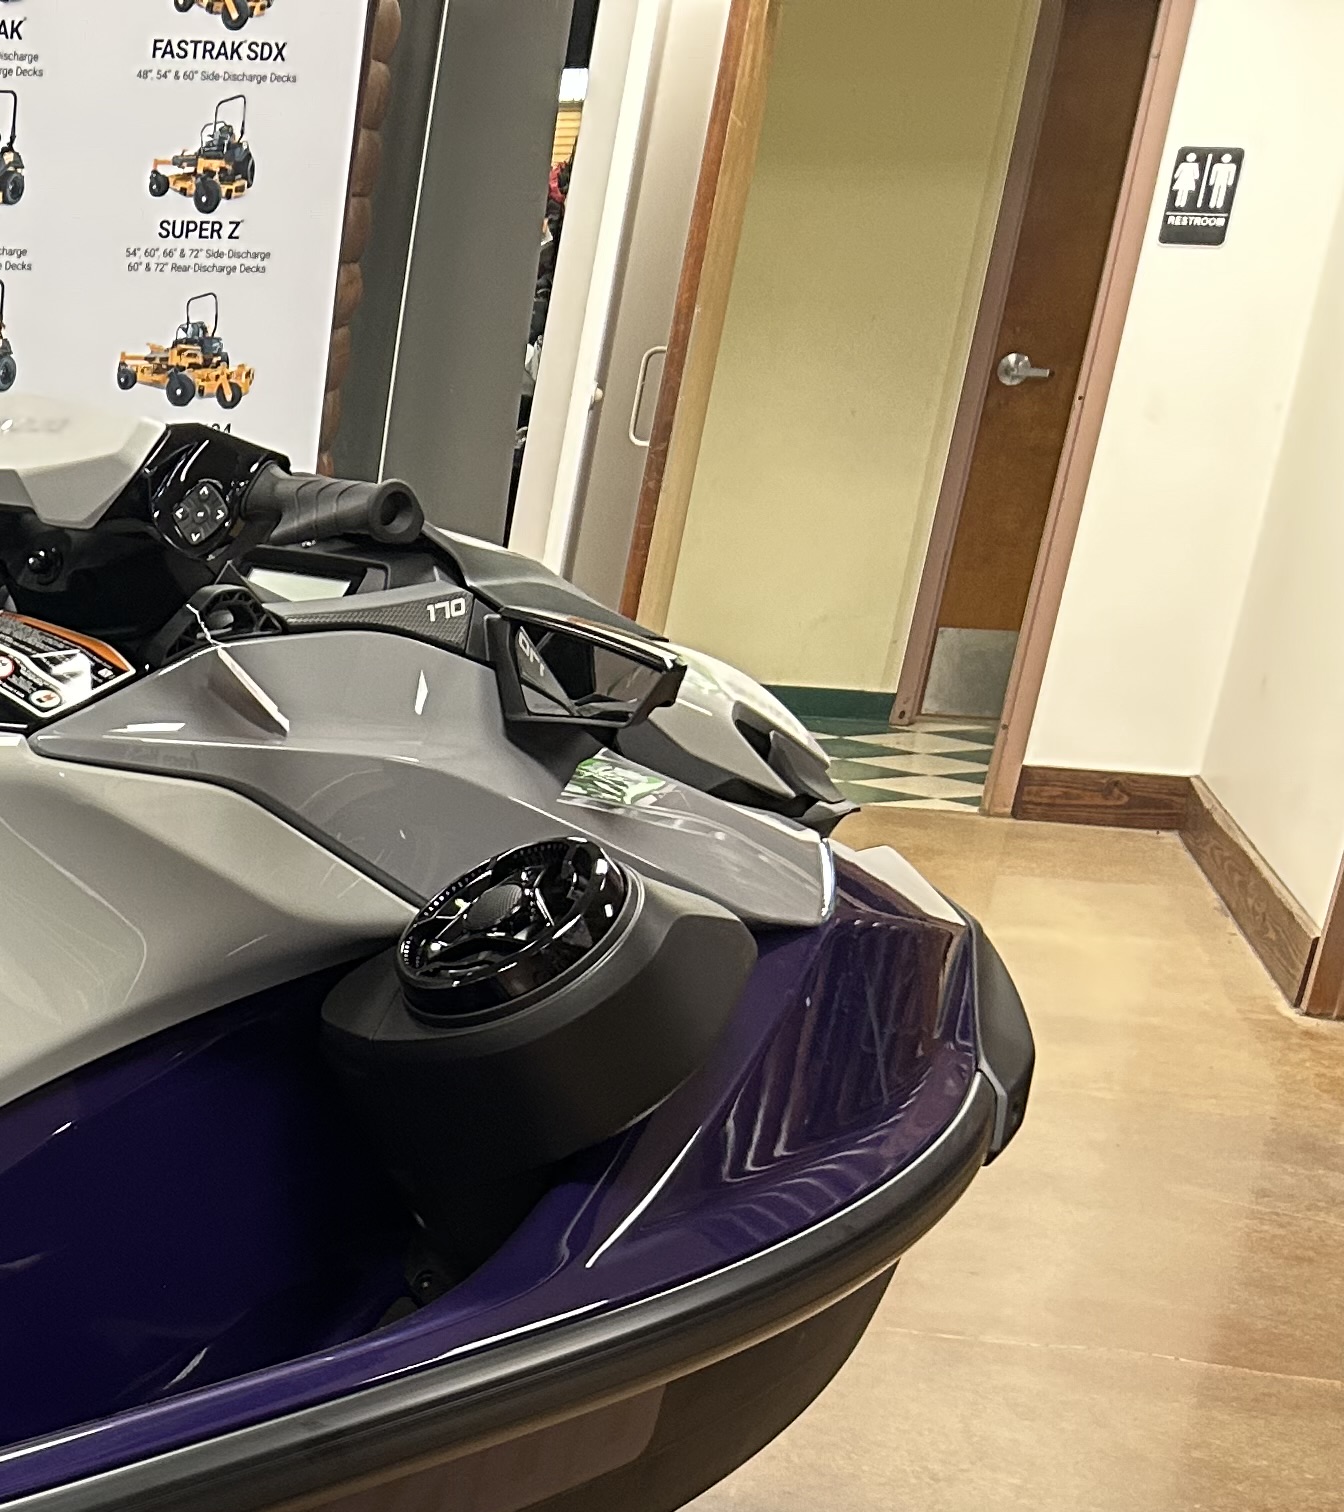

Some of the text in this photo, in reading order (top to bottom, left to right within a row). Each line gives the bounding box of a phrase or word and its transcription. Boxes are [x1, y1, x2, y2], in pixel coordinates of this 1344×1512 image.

[246, 41, 288, 62] SDX
[16, 66, 44, 77] Decks
[174, 70, 180, 80] &
[270, 73, 297, 83] Decks
[1167, 215, 1226, 227] RESTROOM
[158, 220, 242, 239] SUPER Z
[179, 248, 185, 258] &
[4, 261, 32, 271] Decks
[144, 262, 151, 272] &
[239, 264, 266, 273] Decks
[426, 597, 466, 621] 170
